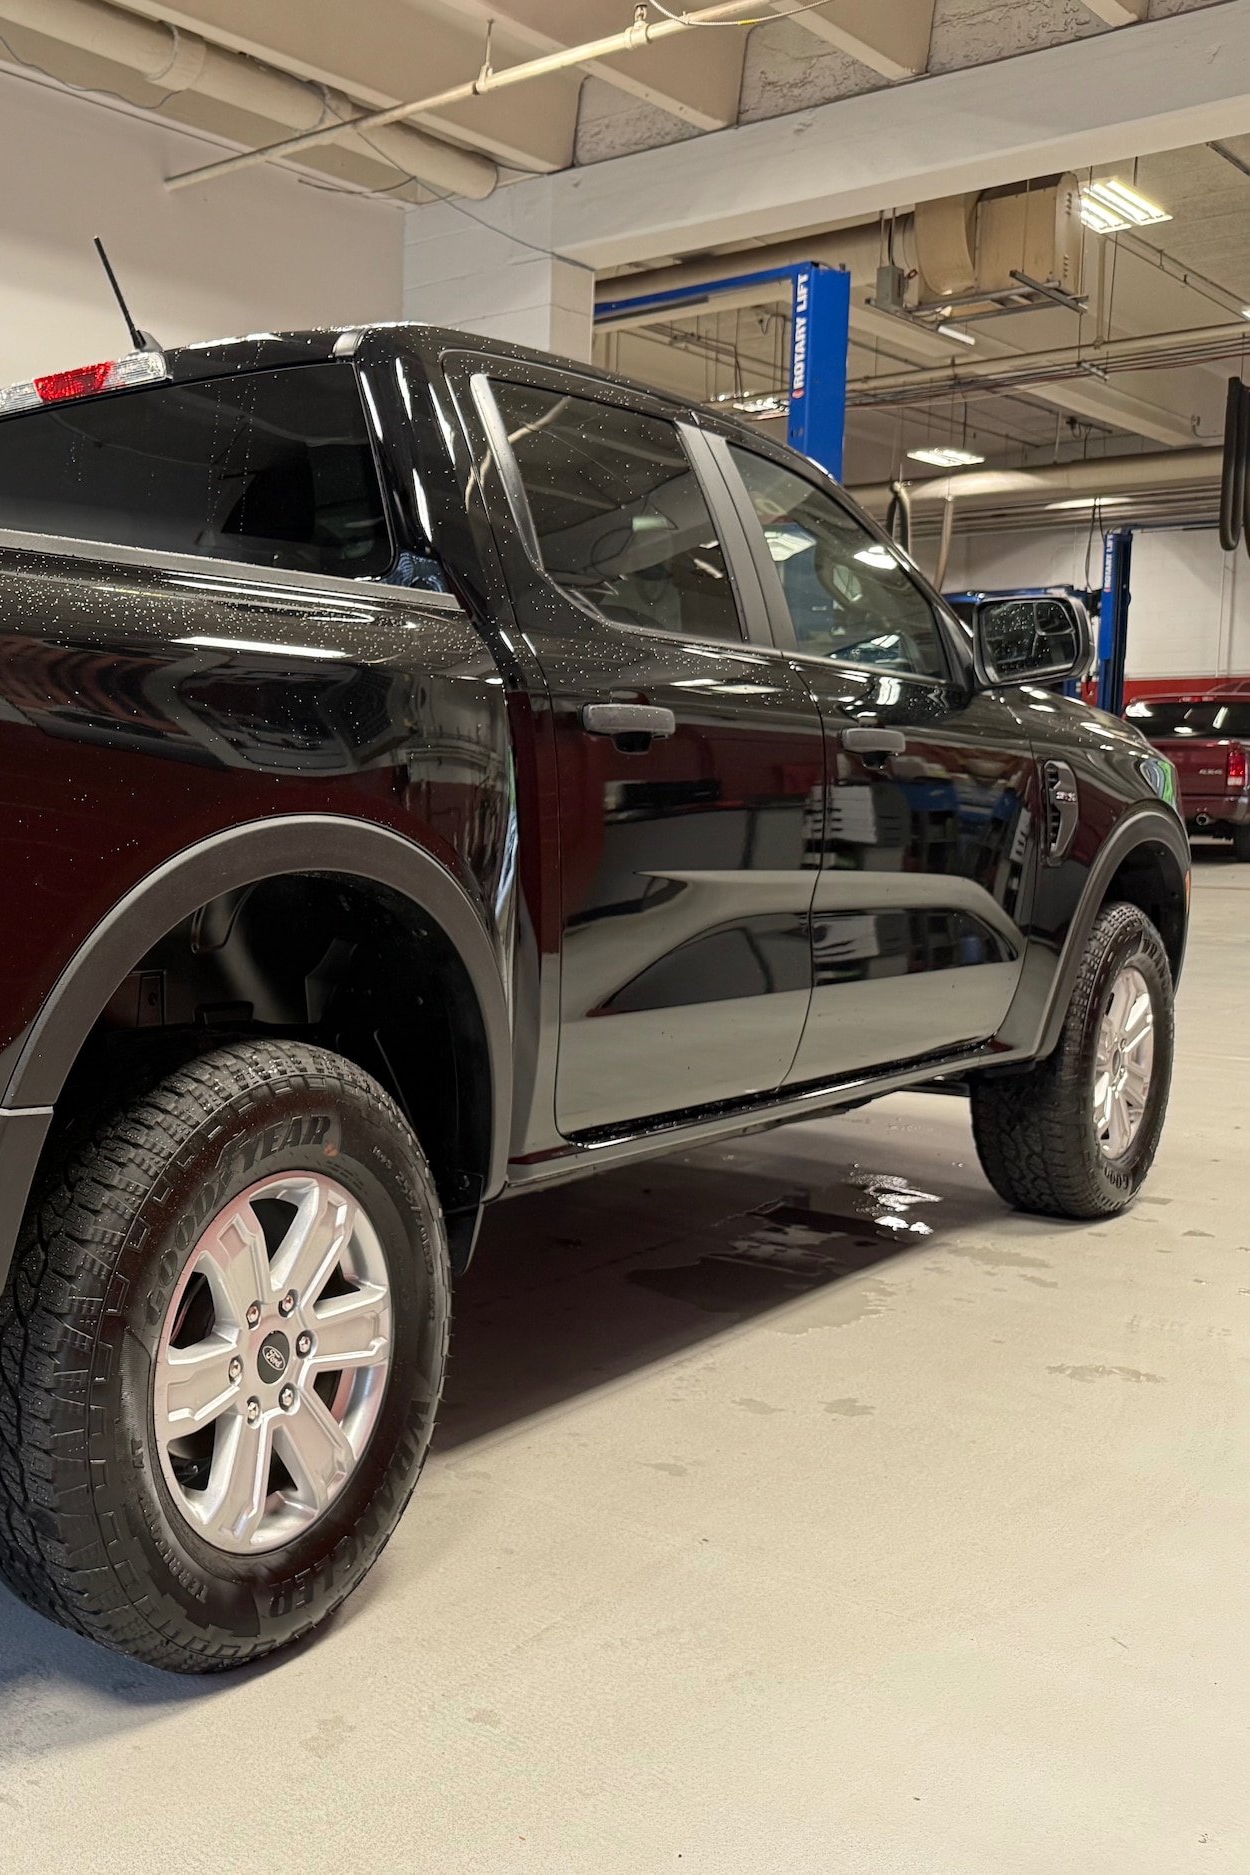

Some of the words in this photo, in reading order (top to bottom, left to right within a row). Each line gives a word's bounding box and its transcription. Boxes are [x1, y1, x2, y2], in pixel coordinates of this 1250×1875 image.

[796, 273, 809, 313] LIFT
[793, 316, 807, 389] ROTARY
[146, 1114, 330, 1326] GOODYEAR
